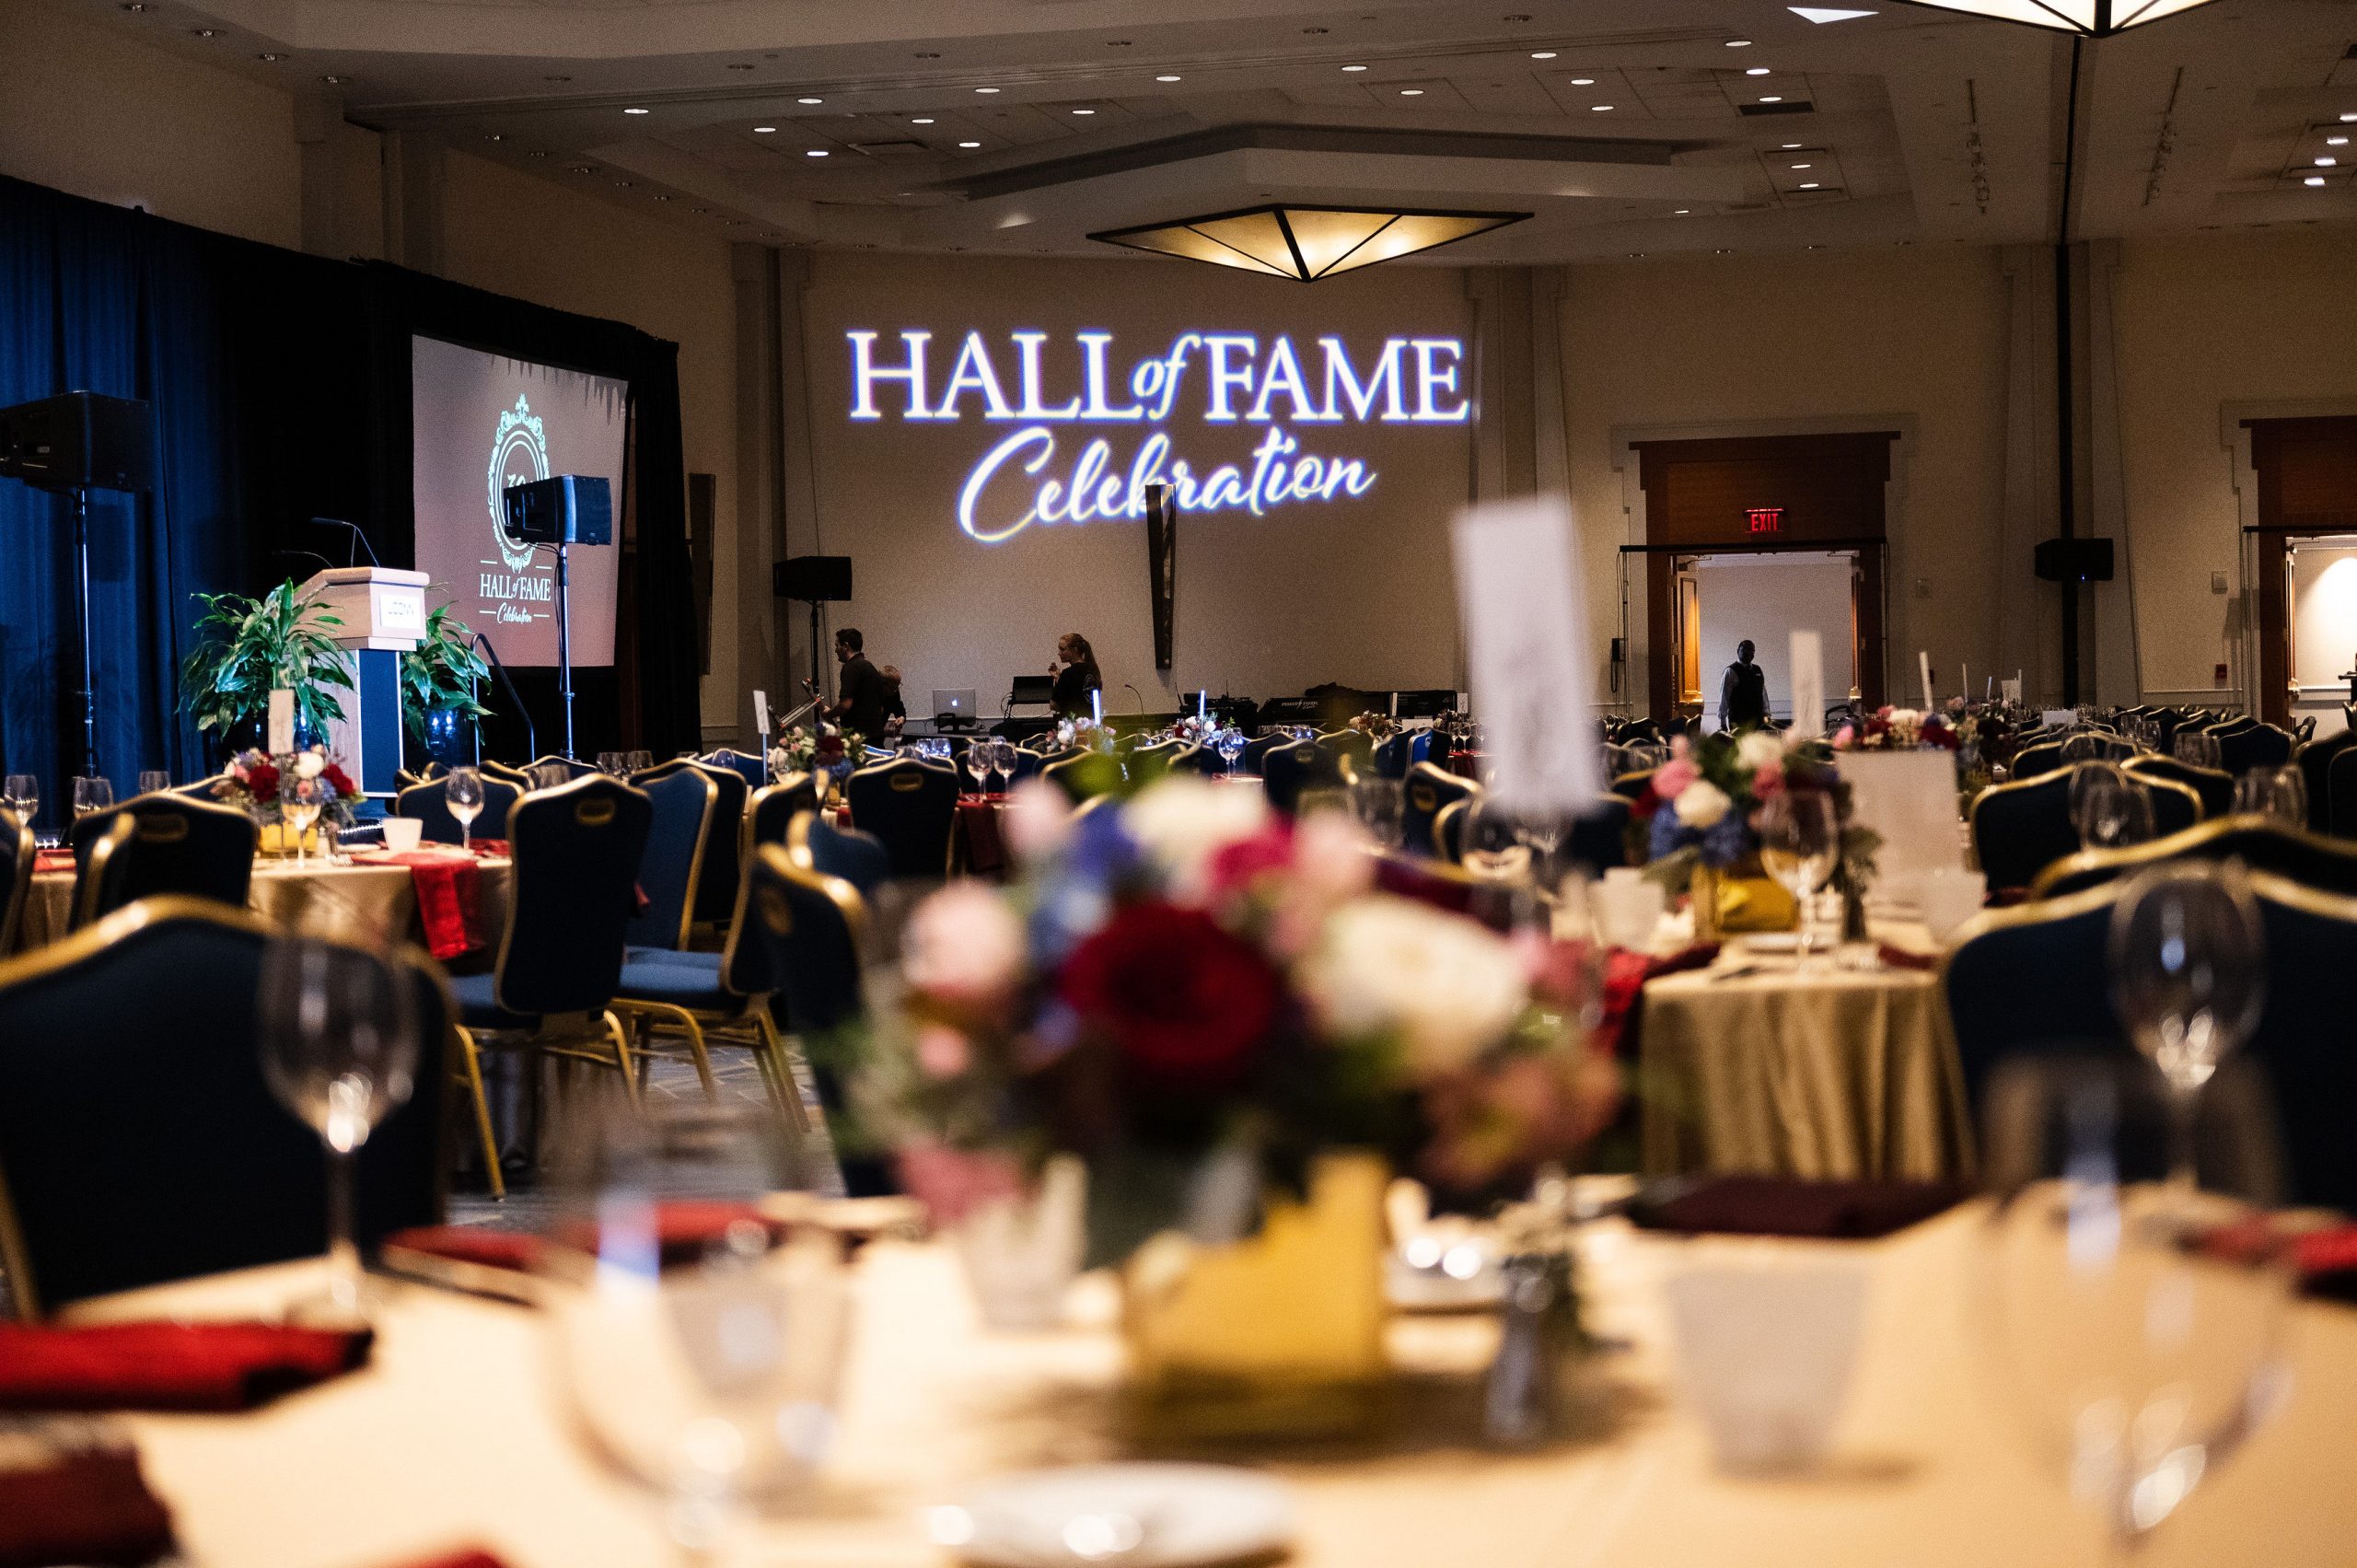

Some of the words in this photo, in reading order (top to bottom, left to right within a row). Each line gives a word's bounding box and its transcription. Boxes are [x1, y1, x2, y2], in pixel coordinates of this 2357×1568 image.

[845, 330, 1143, 420] HALL
[1132, 334, 1202, 421] of
[1203, 336, 1469, 422] FAME
[958, 426, 1377, 543] Celebration
[1751, 513, 1779, 531] EXIT
[480, 573, 514, 598] HALL
[512, 577, 521, 598] of
[519, 576, 552, 601] FAME
[497, 601, 532, 624] Celebration
